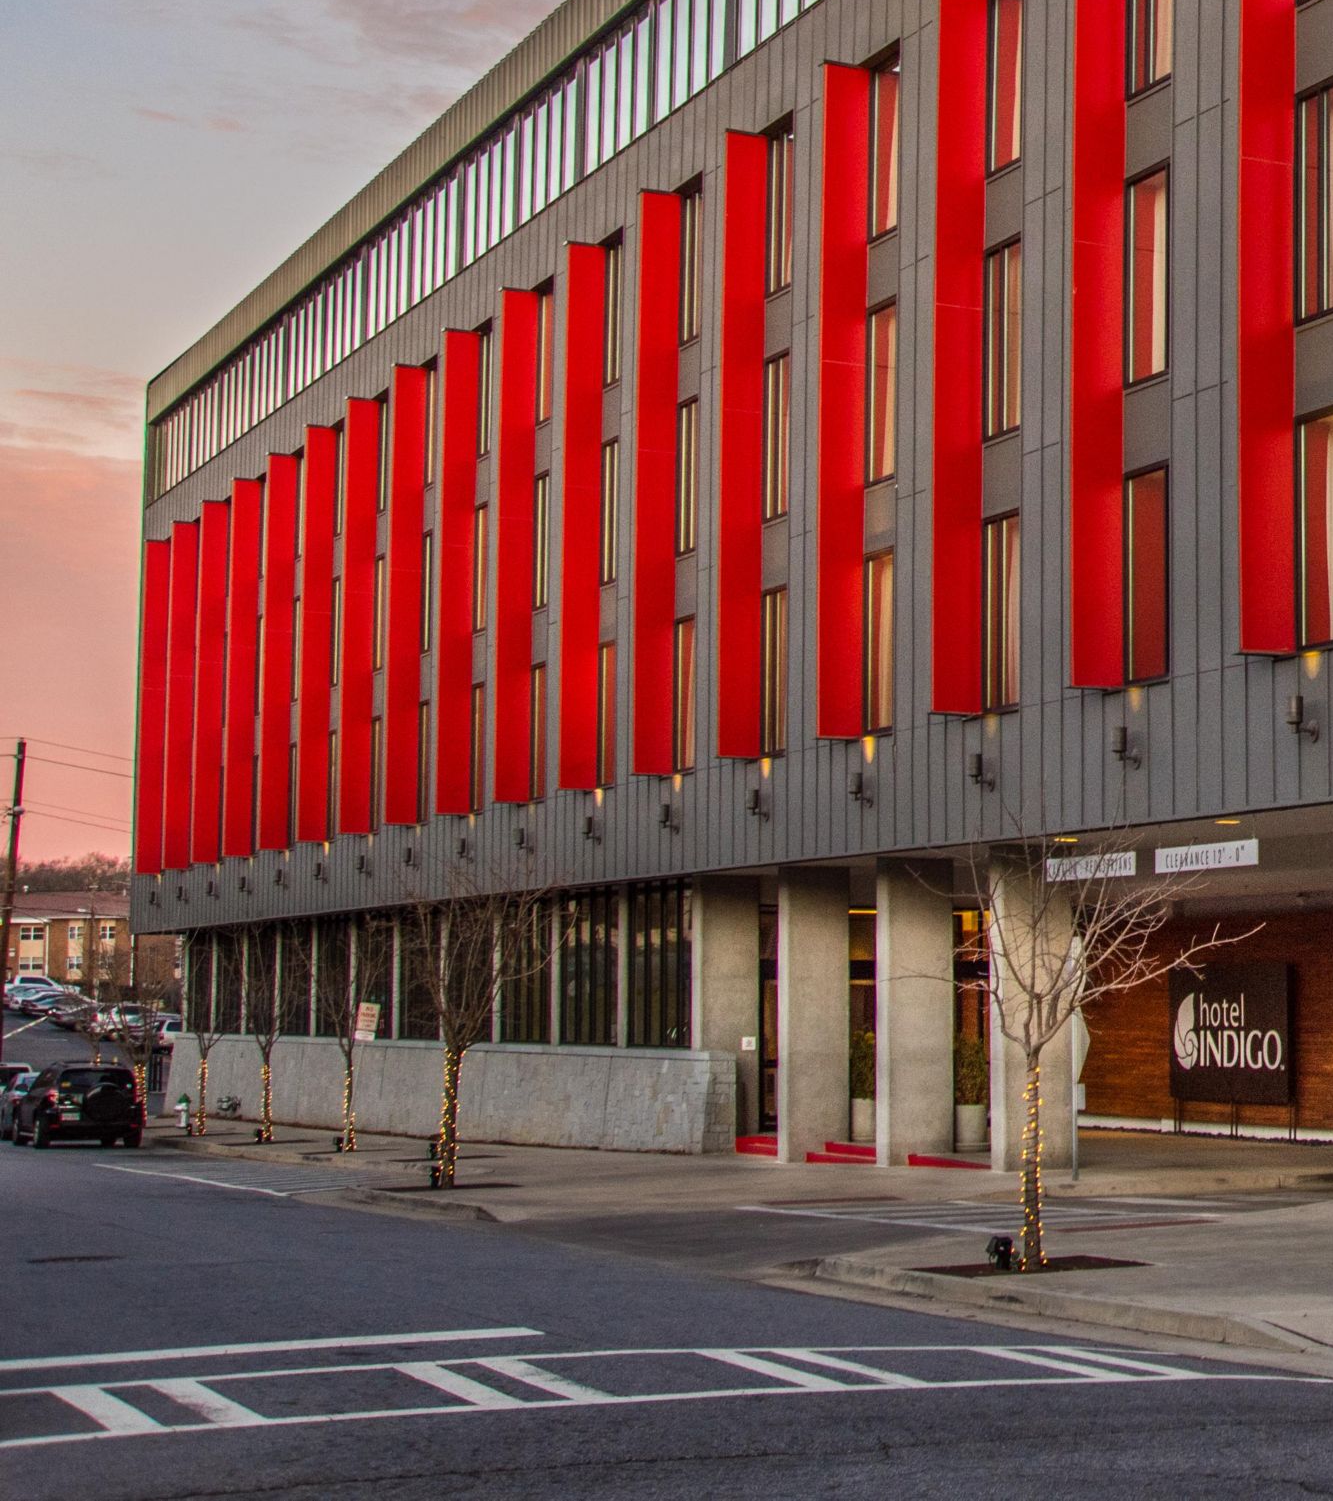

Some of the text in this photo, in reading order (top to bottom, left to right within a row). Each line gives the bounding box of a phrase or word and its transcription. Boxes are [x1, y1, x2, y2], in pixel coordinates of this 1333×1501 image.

[1165, 850, 1209, 868] CLEARANCE
[1199, 992, 1245, 1028] hotel
[1199, 1029, 1282, 1070] INDIGO
